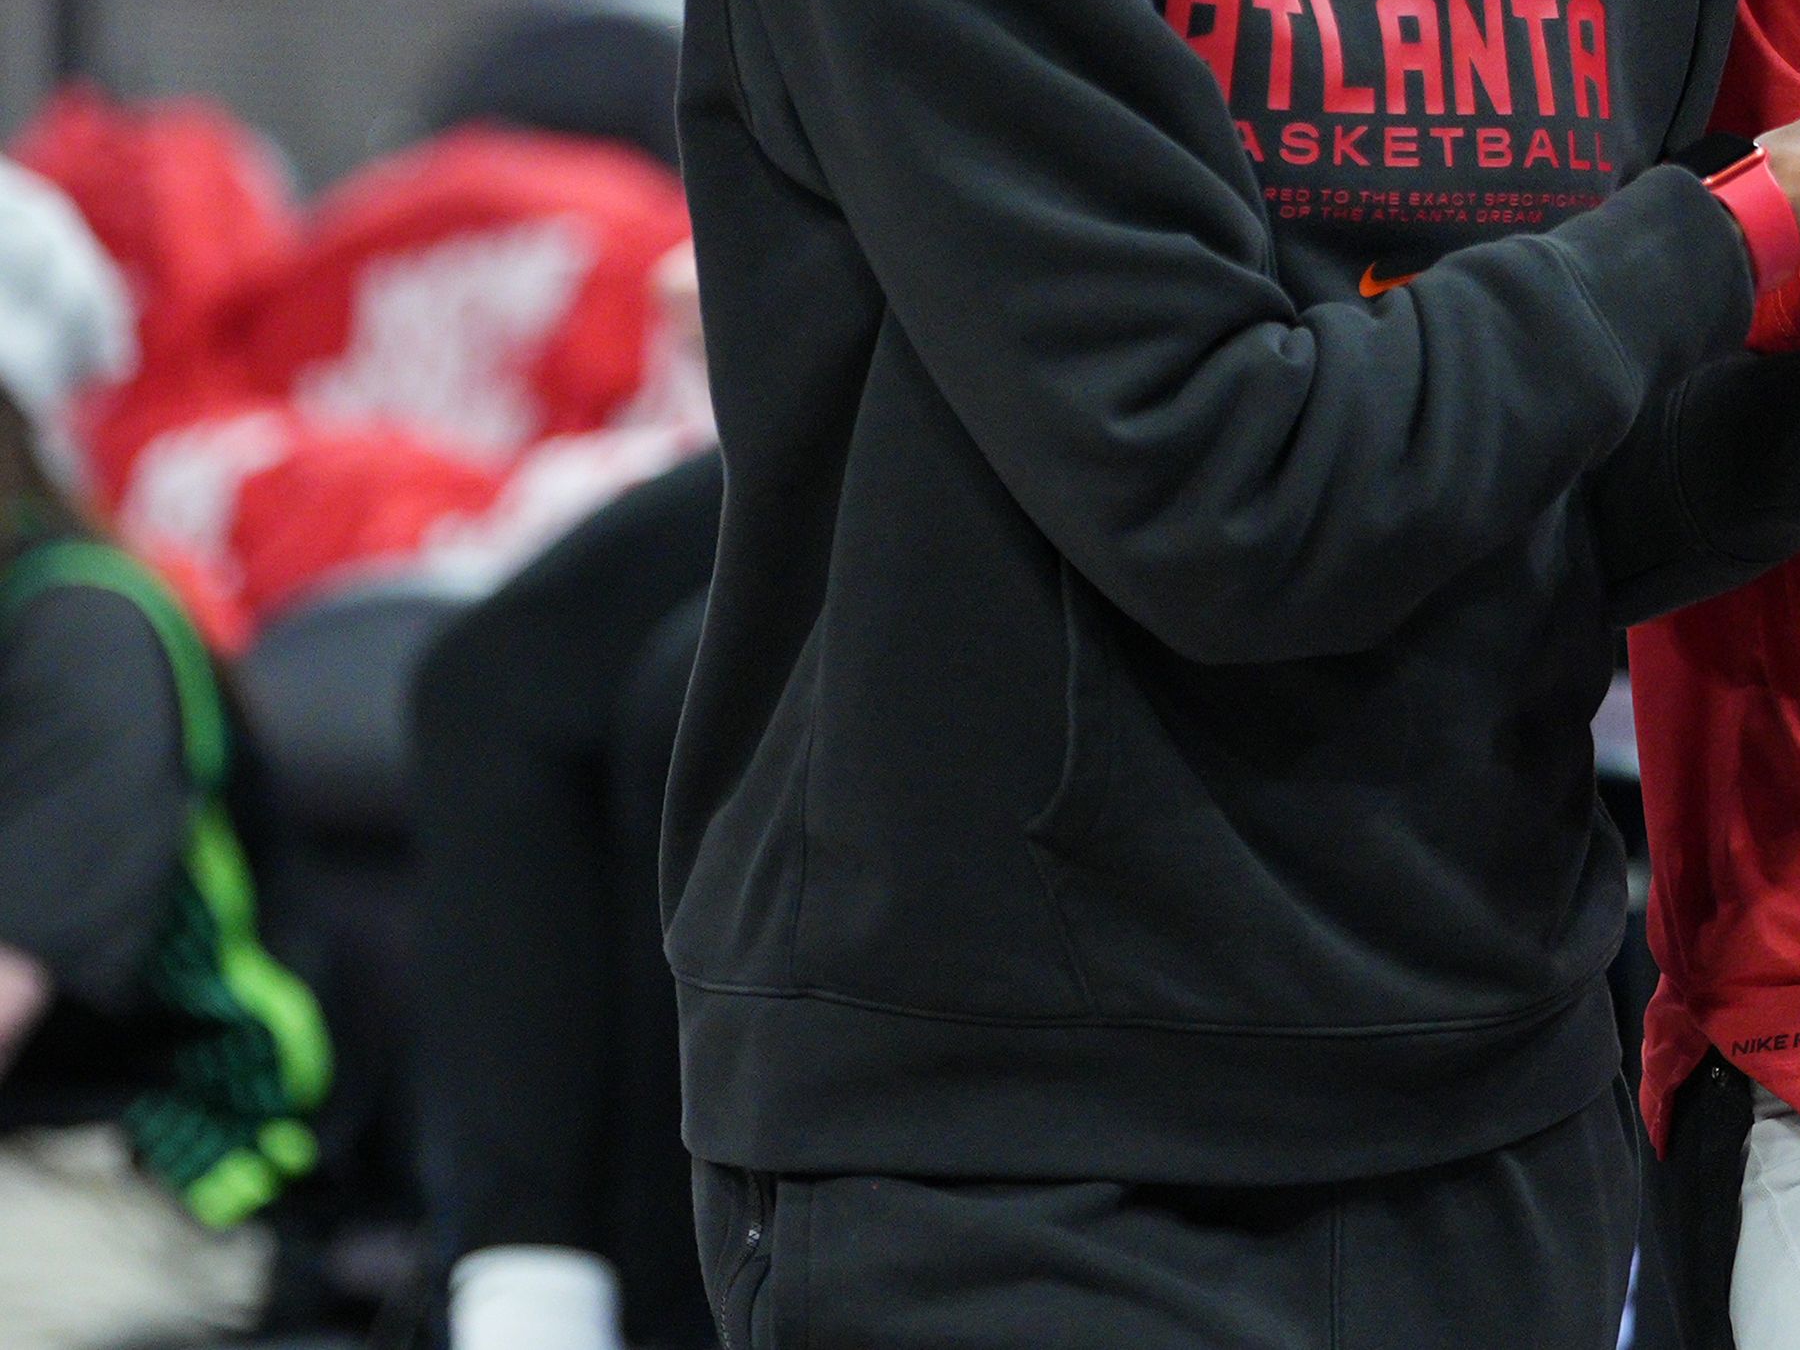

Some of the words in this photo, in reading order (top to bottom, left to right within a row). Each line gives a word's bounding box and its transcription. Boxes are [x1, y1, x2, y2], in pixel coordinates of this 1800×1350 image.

[1235, 119, 1612, 171] ASKETBALL
[1321, 188, 1350, 204] TO
[1359, 190, 1400, 206] THE
[1409, 192, 1477, 207] EXACT
[1321, 205, 1364, 223] THE
[1373, 207, 1469, 224] ATLANTA
[1476, 208, 1545, 225] DREAM
[1732, 1033, 1789, 1057] NIKE
